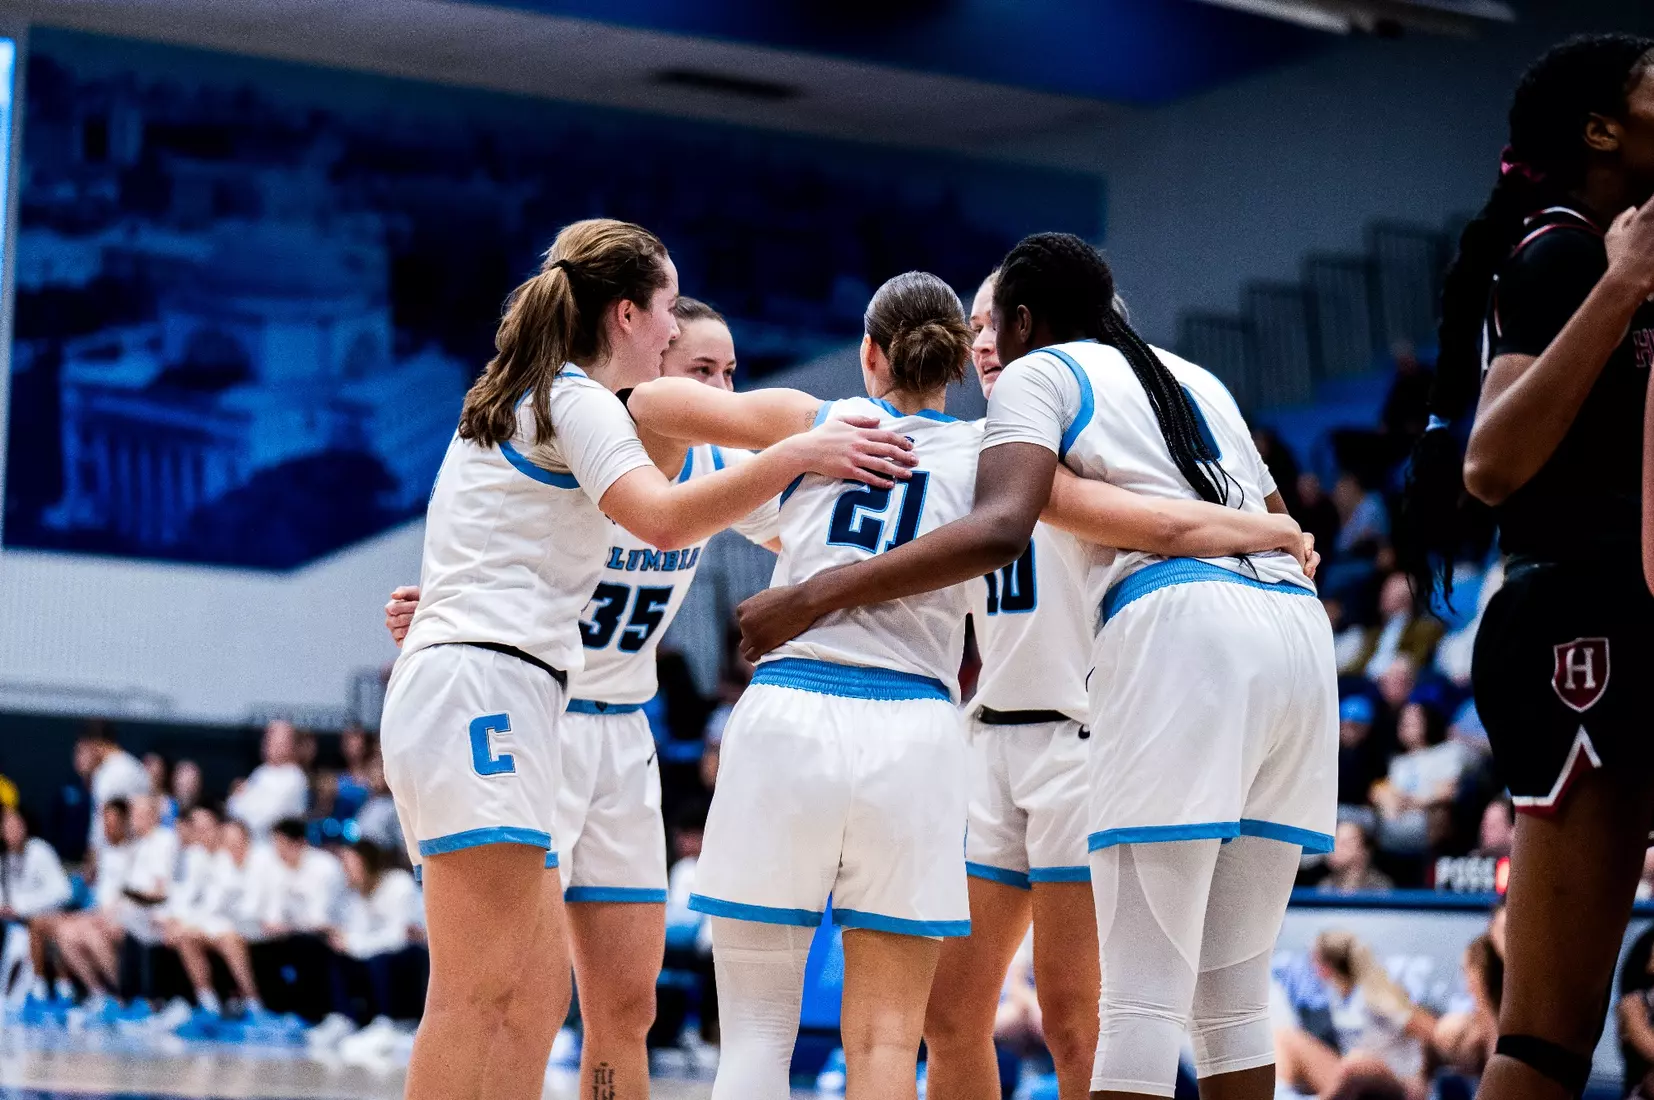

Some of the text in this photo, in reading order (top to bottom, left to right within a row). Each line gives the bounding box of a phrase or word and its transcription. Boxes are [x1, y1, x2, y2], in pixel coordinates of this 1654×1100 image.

[826, 468, 930, 554] 21
[578, 580, 675, 654] 35
[1564, 647, 1597, 690] H
[468, 712, 517, 776] C
